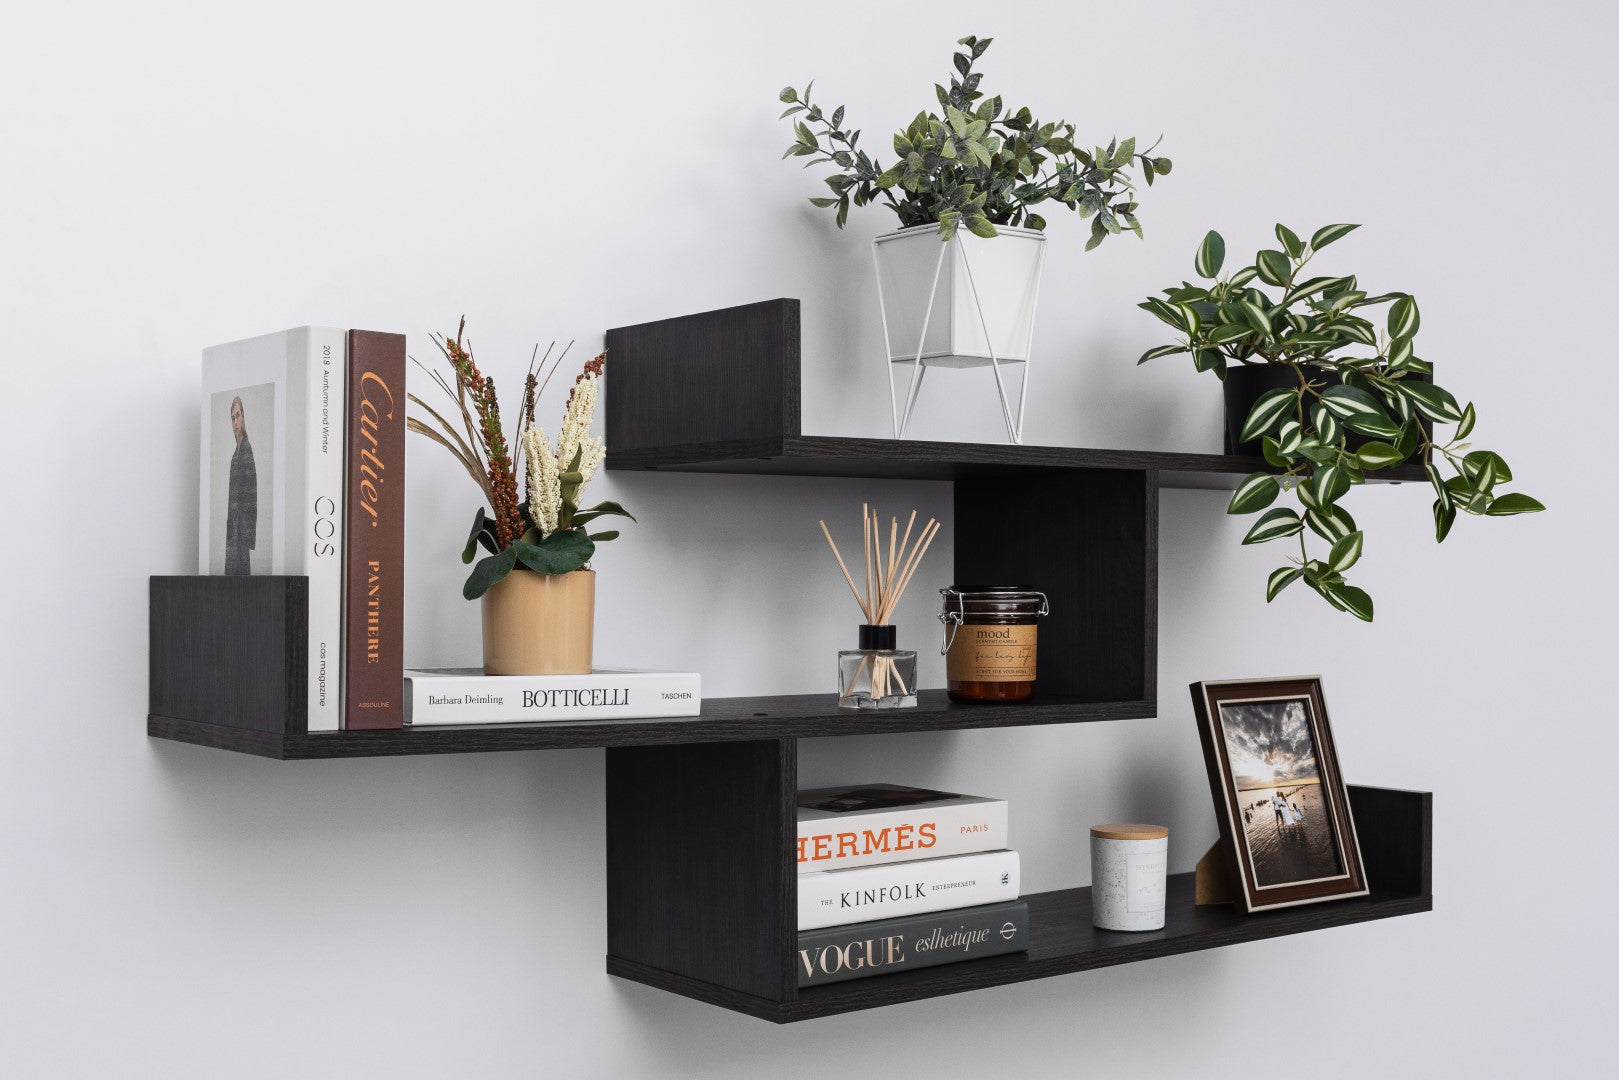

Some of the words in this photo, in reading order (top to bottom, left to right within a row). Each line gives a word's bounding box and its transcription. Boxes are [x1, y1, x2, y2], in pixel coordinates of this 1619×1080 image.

[322, 345, 331, 366] 2018
[360, 371, 394, 528] Cartier
[314, 495, 335, 558] COS
[367, 560, 381, 664] PANTHERE
[976, 627, 1010, 639] mood
[317, 660, 327, 707] magazine
[428, 695, 462, 705] Barbara
[464, 694, 504, 706] Deimling
[521, 688, 630, 708] BOTTICELLI
[660, 692, 692, 700] TASCHEN
[960, 824, 989, 834] PARIS
[820, 899, 833, 907] THE
[840, 882, 927, 908] KINFOLK
[798, 934, 905, 978] VOGUE
